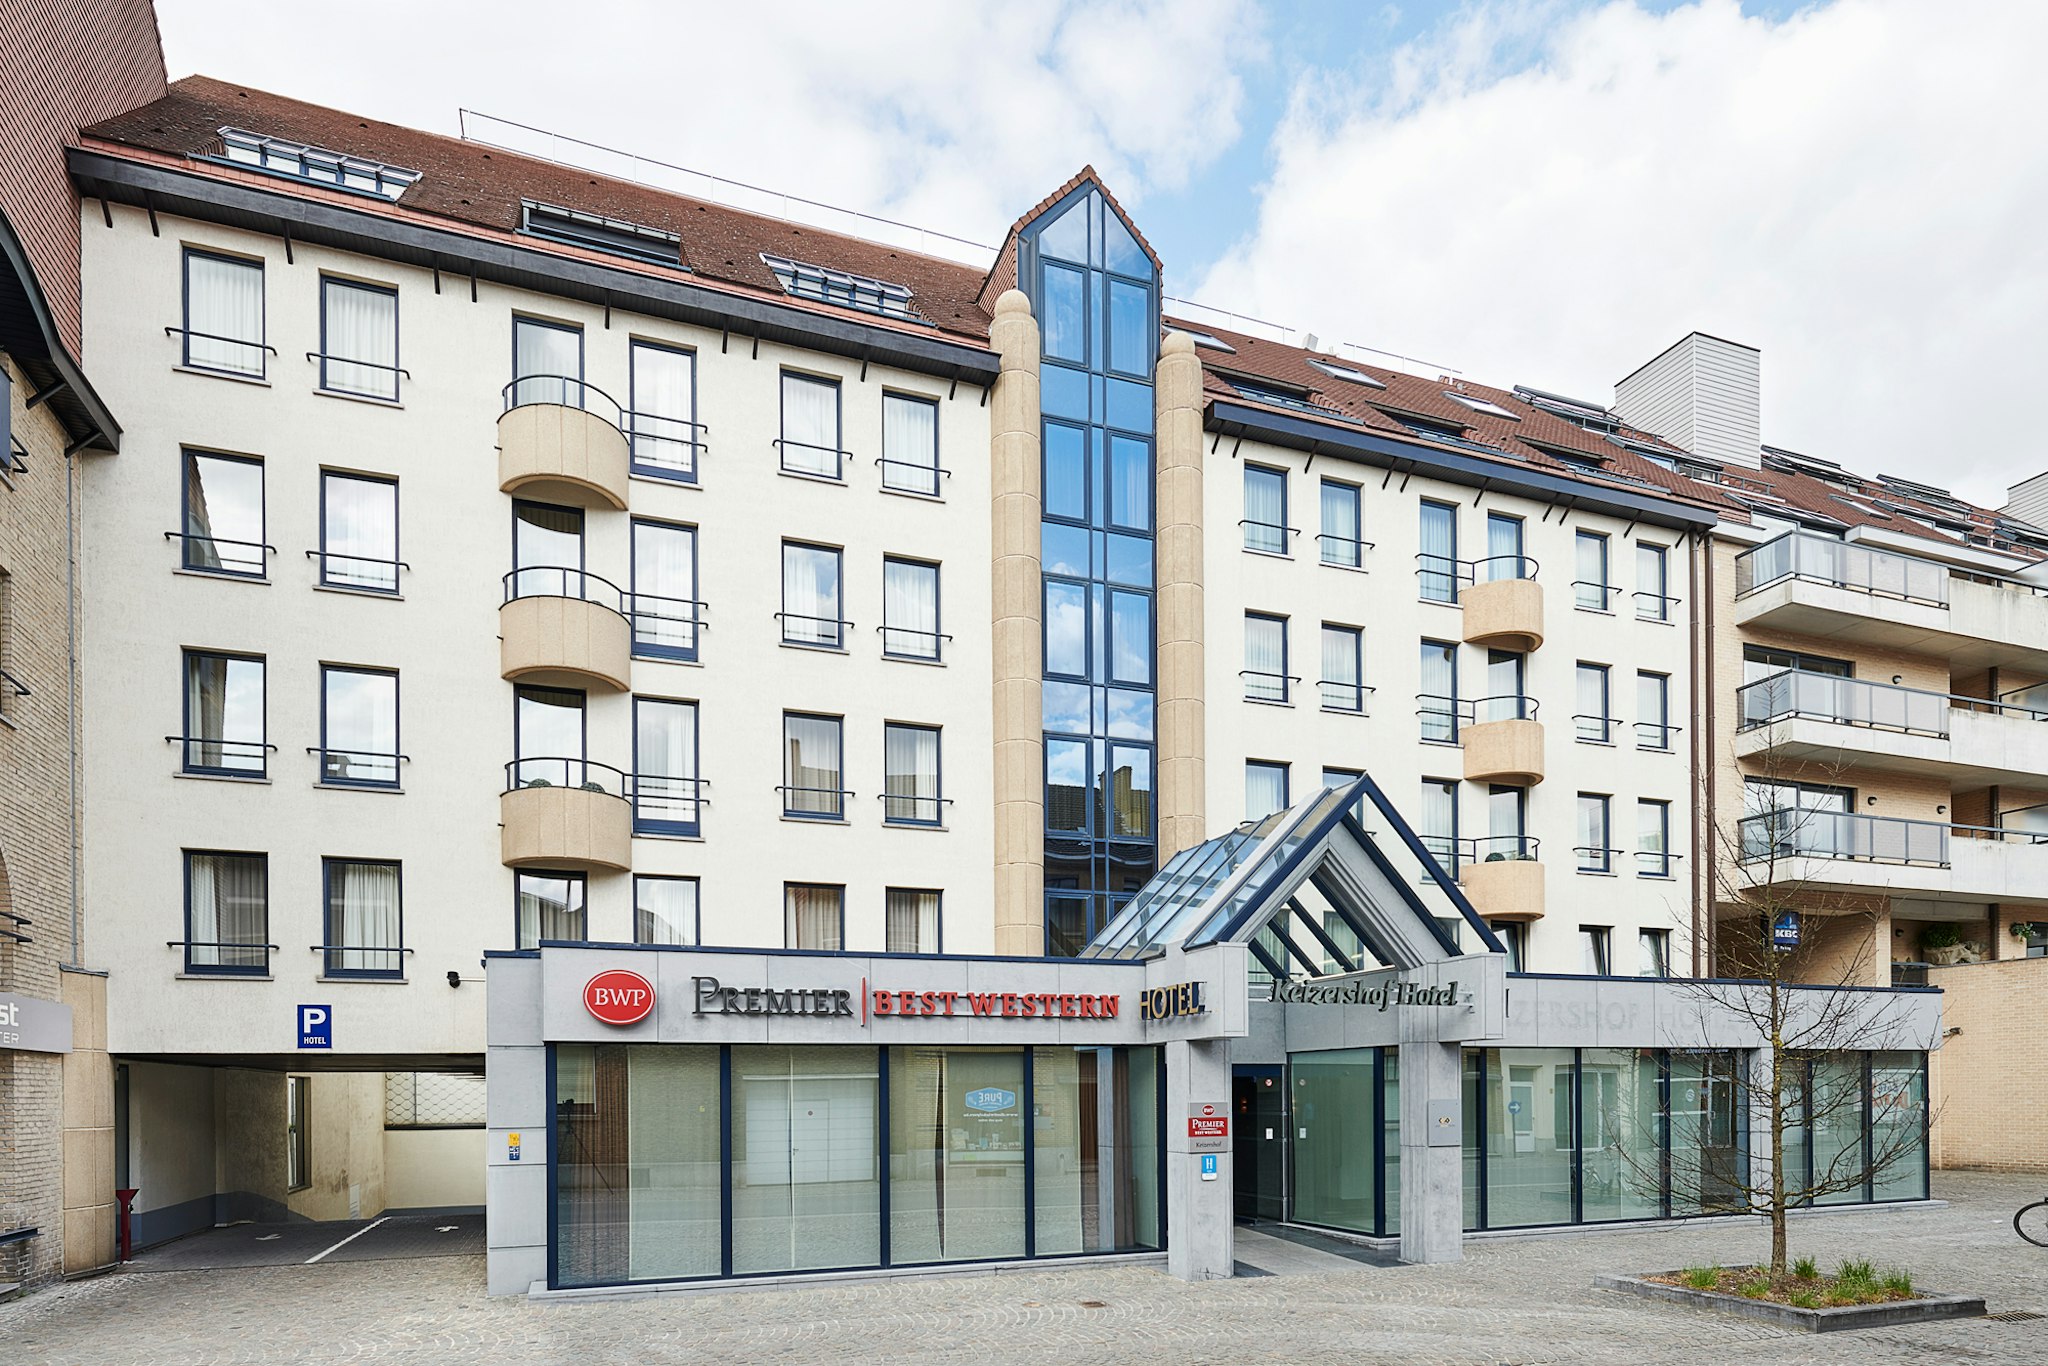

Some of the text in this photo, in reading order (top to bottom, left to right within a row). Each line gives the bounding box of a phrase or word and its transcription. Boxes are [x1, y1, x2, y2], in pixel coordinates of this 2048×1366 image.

[1774, 929, 1798, 939] KBC
[594, 987, 646, 1007] BWP
[691, 976, 1120, 1018] PREMIER BEST WESTERN
[1139, 981, 1204, 1021] HOTEL
[1268, 979, 1459, 1012] Keizershof Hotel
[303, 1008, 327, 1034] P
[303, 1036, 327, 1045] HOTEL
[1192, 1119, 1225, 1129] PREMIER
[1206, 1157, 1214, 1170] H
